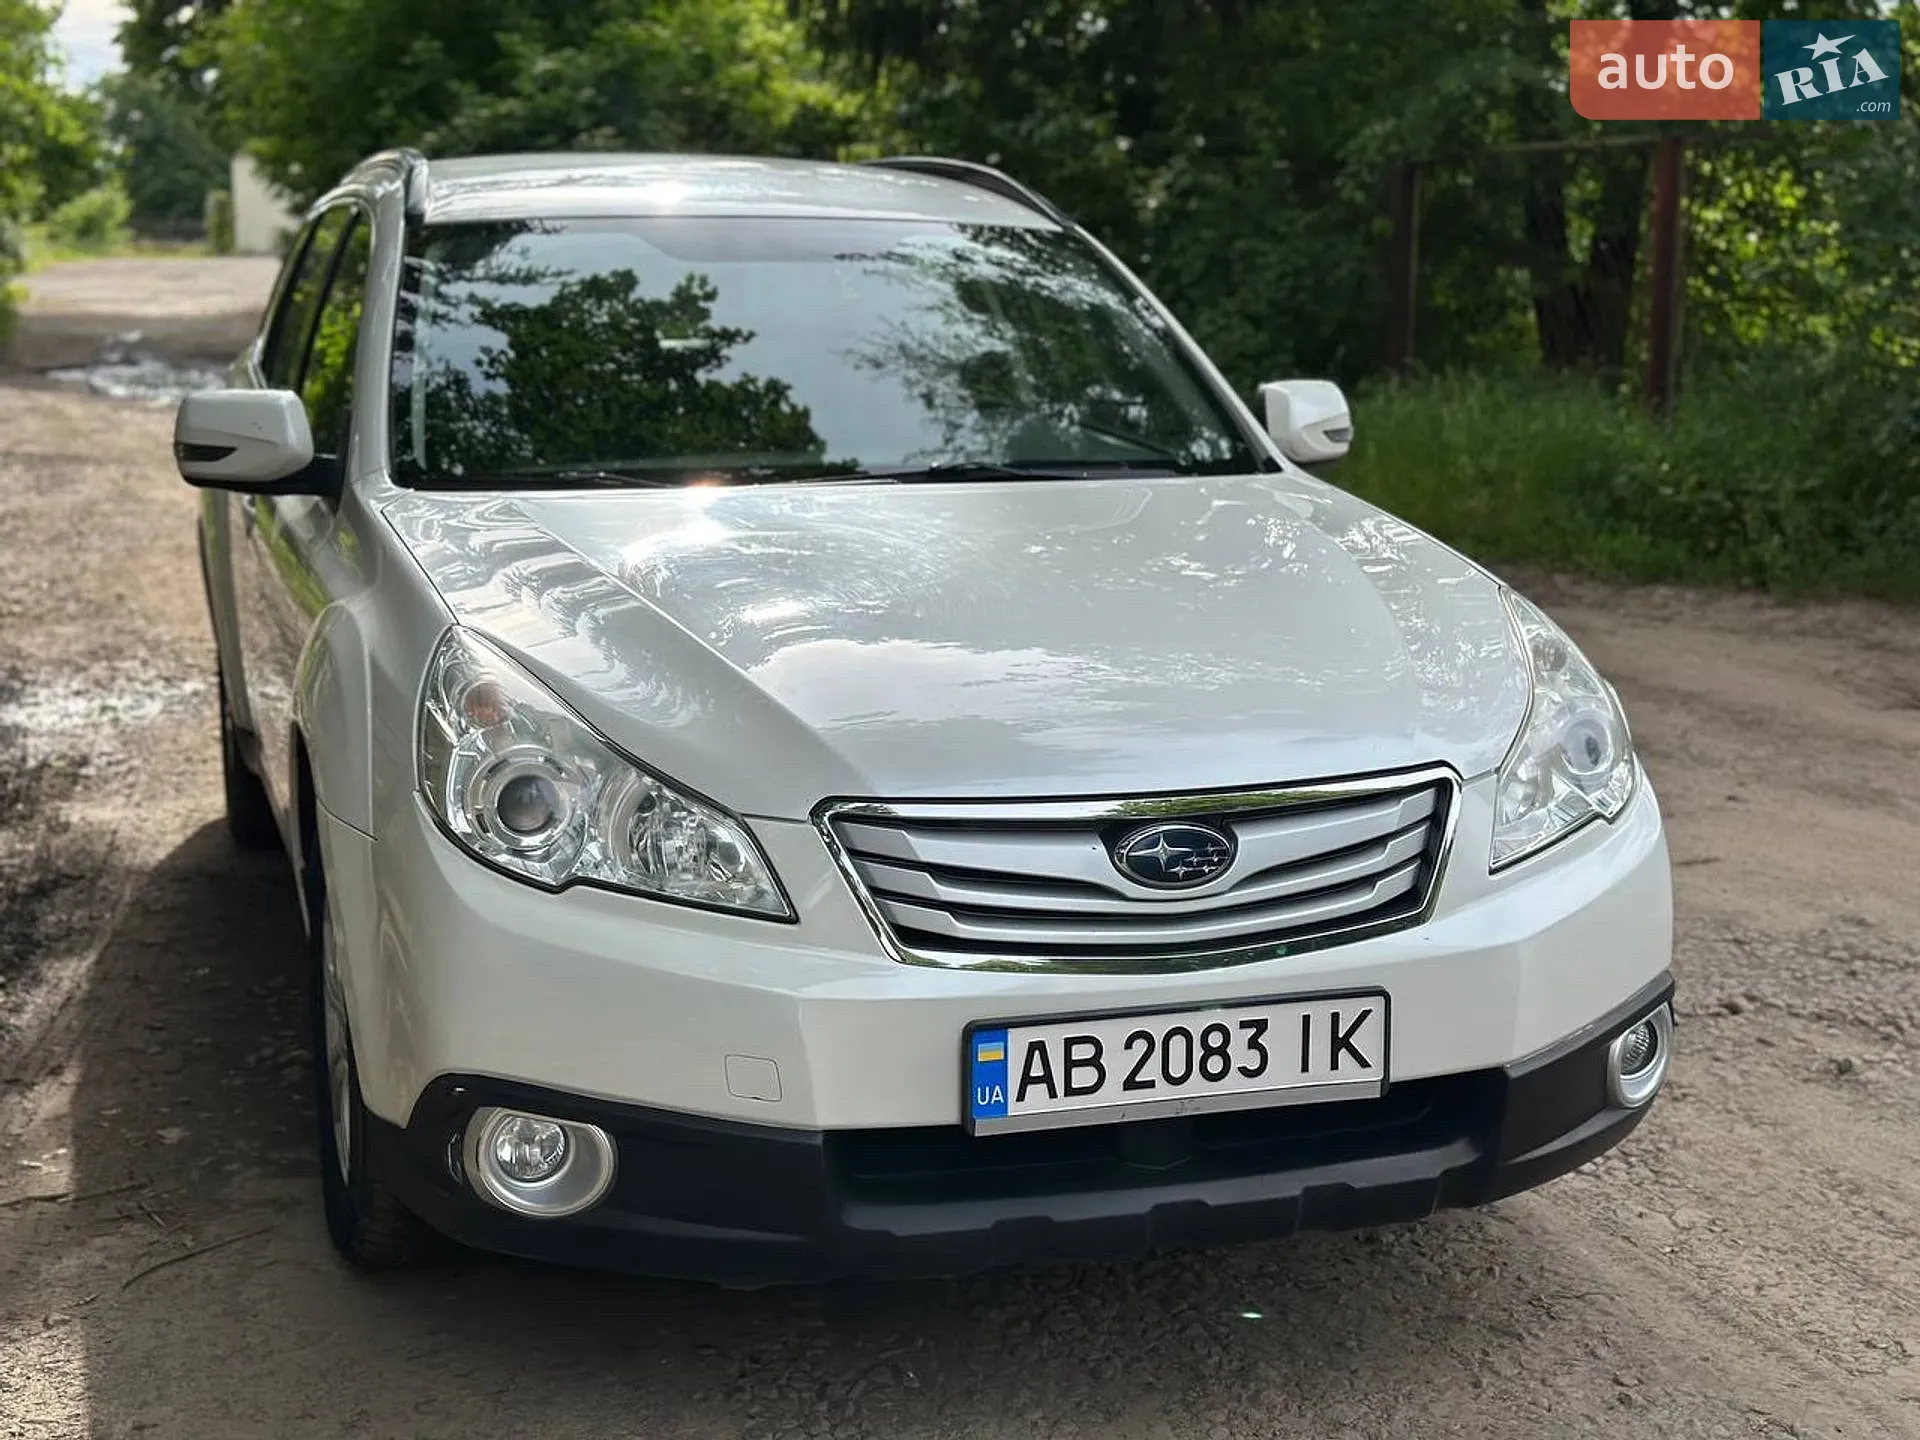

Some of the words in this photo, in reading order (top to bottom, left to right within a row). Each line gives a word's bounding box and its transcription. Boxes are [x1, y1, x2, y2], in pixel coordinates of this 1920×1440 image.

[1015, 1035, 1107, 1103] AB
[1122, 1018, 1270, 1091] 2083
[1301, 1008, 1373, 1073] IK
[977, 1086, 1004, 1106] UA
